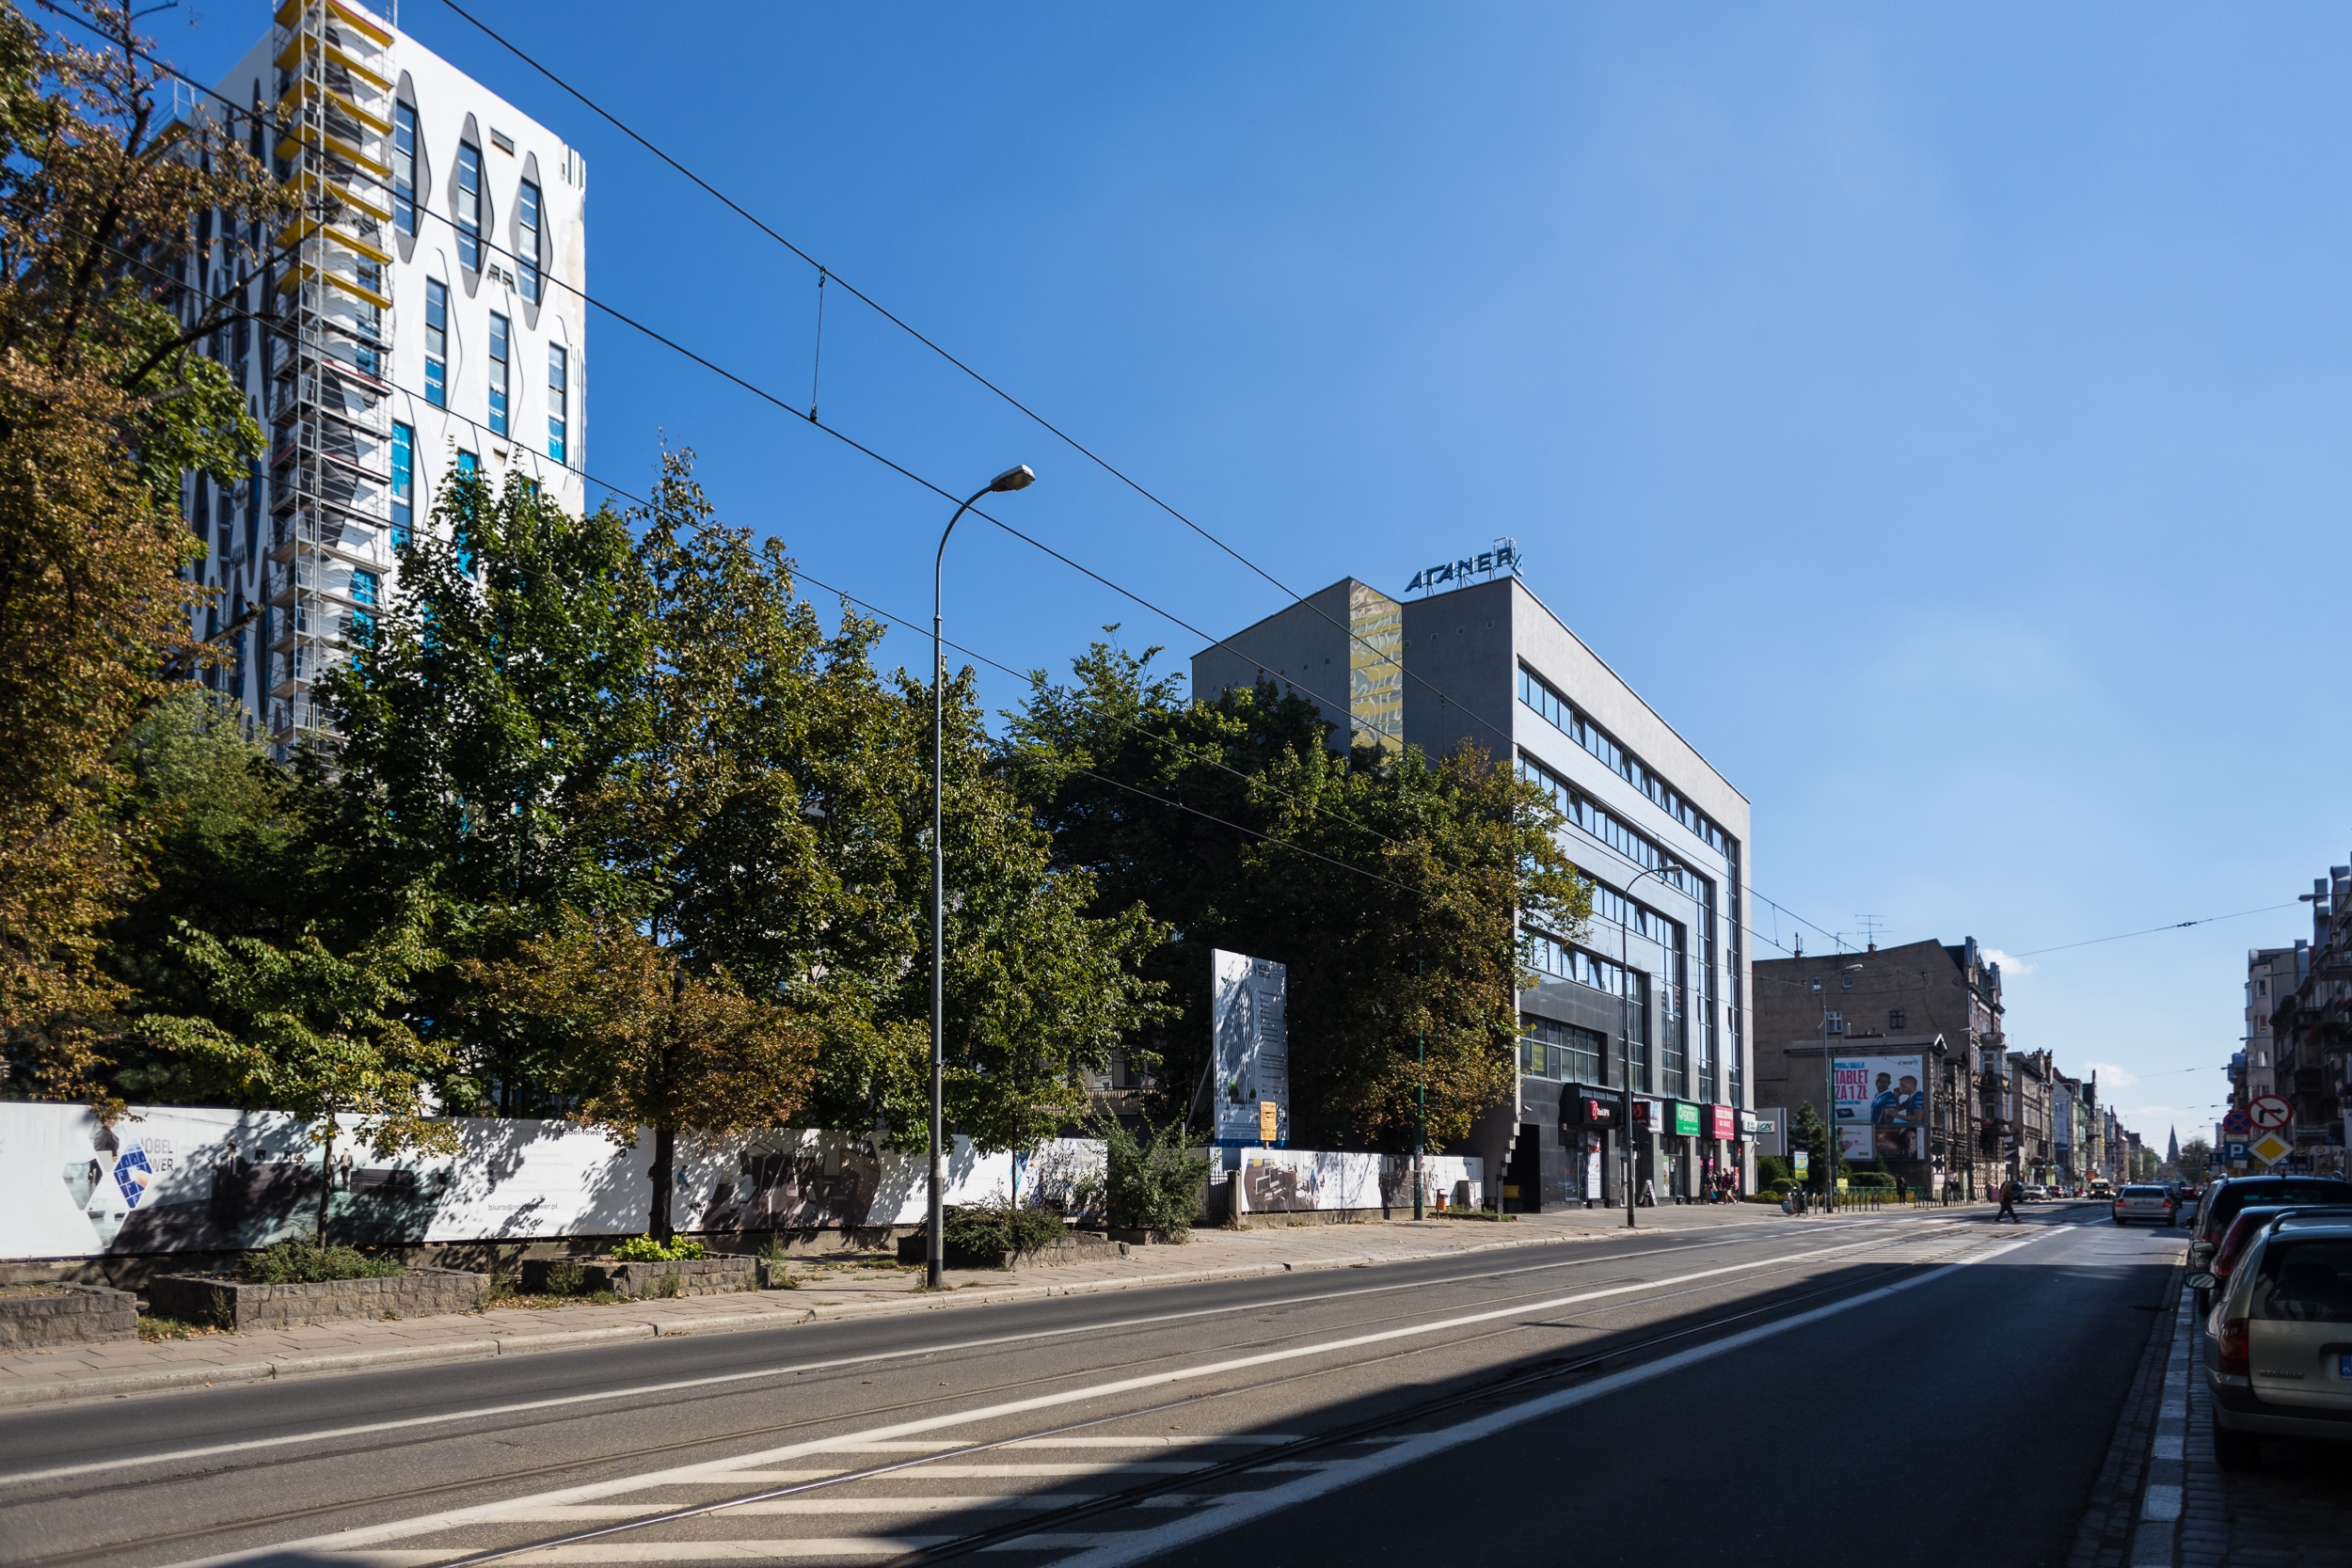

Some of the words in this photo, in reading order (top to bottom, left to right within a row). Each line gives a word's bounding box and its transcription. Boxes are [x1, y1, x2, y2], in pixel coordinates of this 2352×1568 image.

[1405, 546, 1513, 593] ATANER
[1835, 1069, 1868, 1085] TABLET
[1836, 1085, 1848, 1101] ZA
[1849, 1085, 1854, 1100] 1
[1857, 1085, 1868, 1100] ZŁ
[2231, 1144, 2244, 1158] P
[488, 1202, 558, 1212] biuro@nobeltower.pl
[2259, 1370, 2305, 1380] RENAULT
